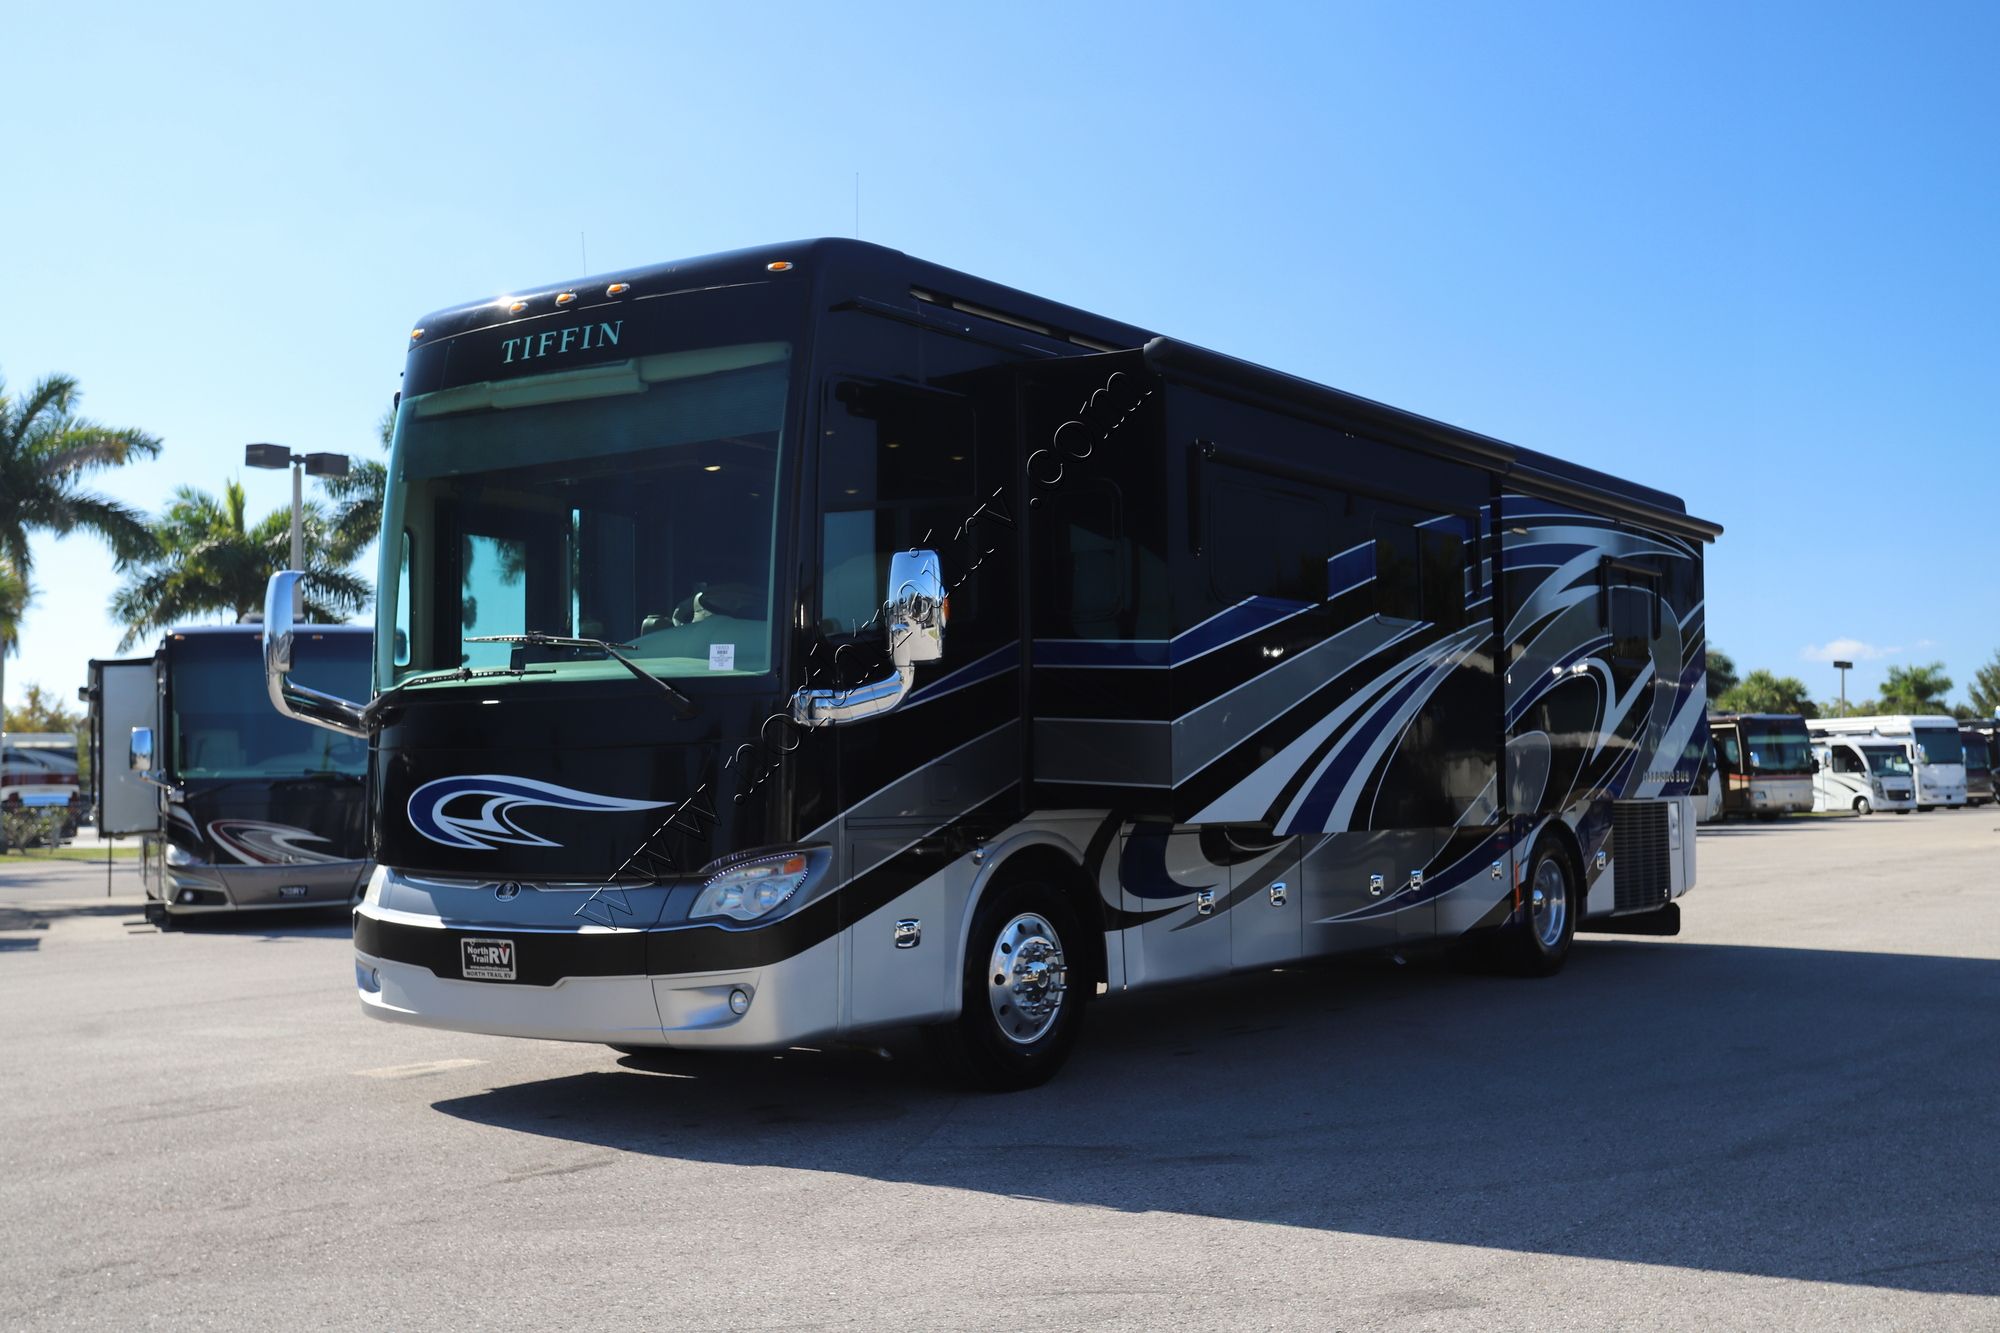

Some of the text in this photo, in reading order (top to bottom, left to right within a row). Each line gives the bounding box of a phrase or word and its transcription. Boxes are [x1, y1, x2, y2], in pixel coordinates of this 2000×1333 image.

[502, 320, 623, 363] TIFFIN
[467, 946, 489, 954] North
[489, 947, 510, 964] RV
[472, 954, 489, 963] Trail
